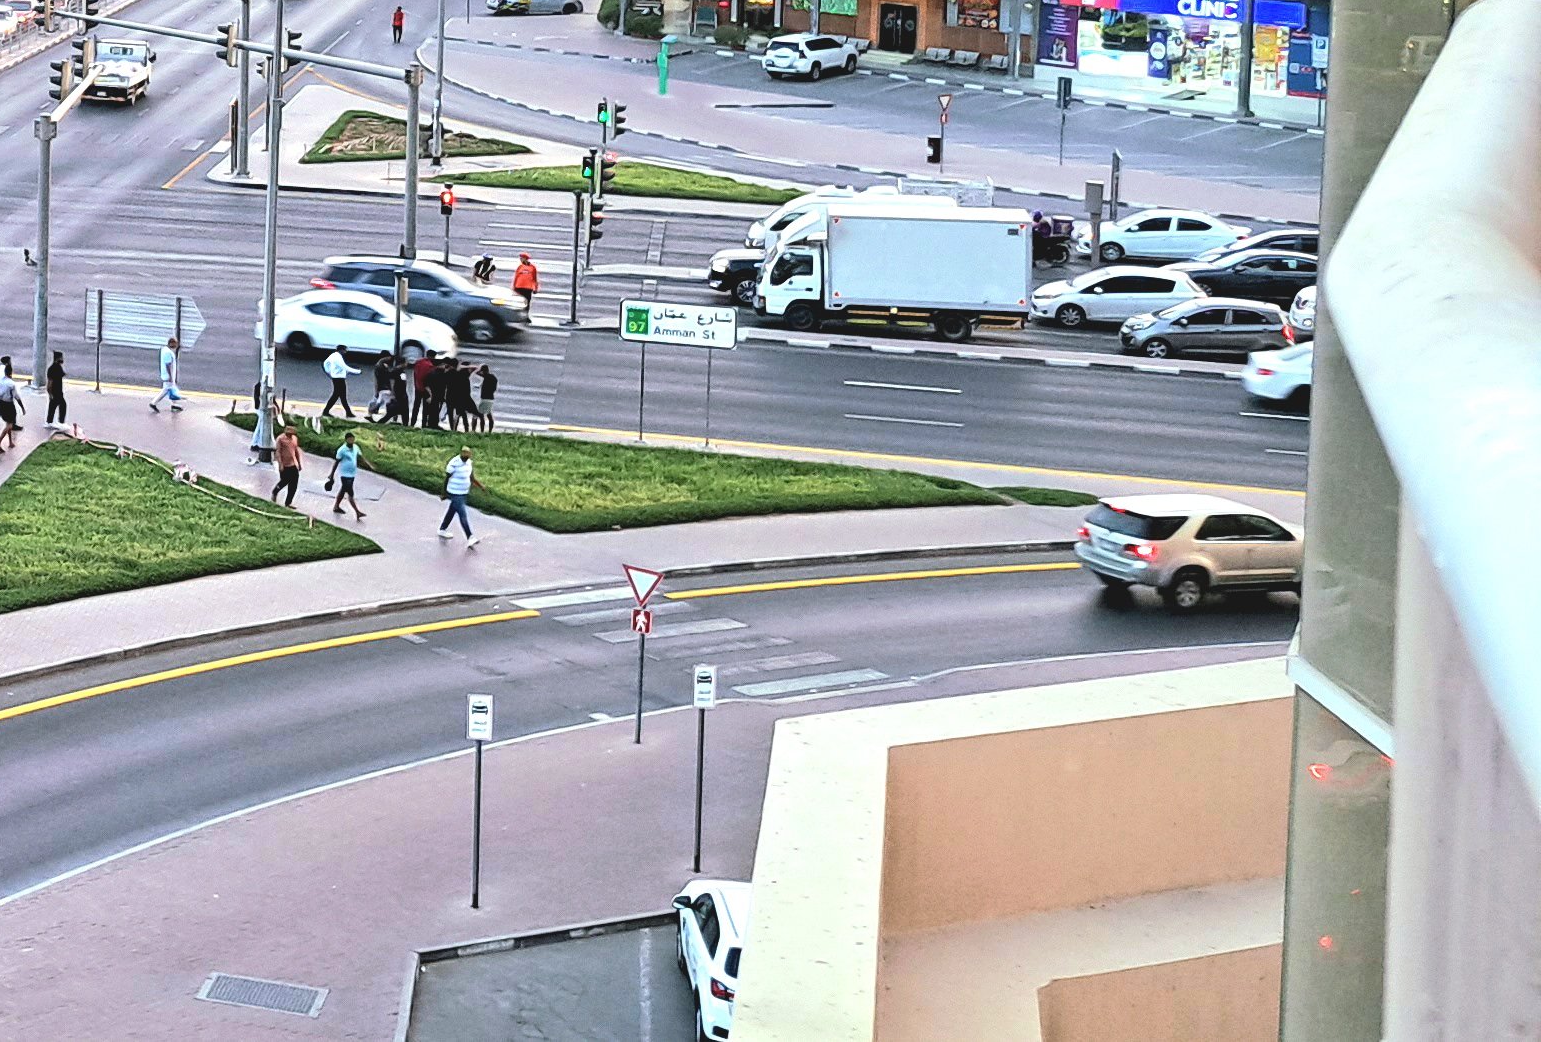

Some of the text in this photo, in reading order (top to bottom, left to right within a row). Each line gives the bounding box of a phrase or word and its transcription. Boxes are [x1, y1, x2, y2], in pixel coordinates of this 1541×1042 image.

[697, 312, 733, 326] شارع
[629, 321, 646, 332] 97
[653, 326, 716, 340] Amman St
